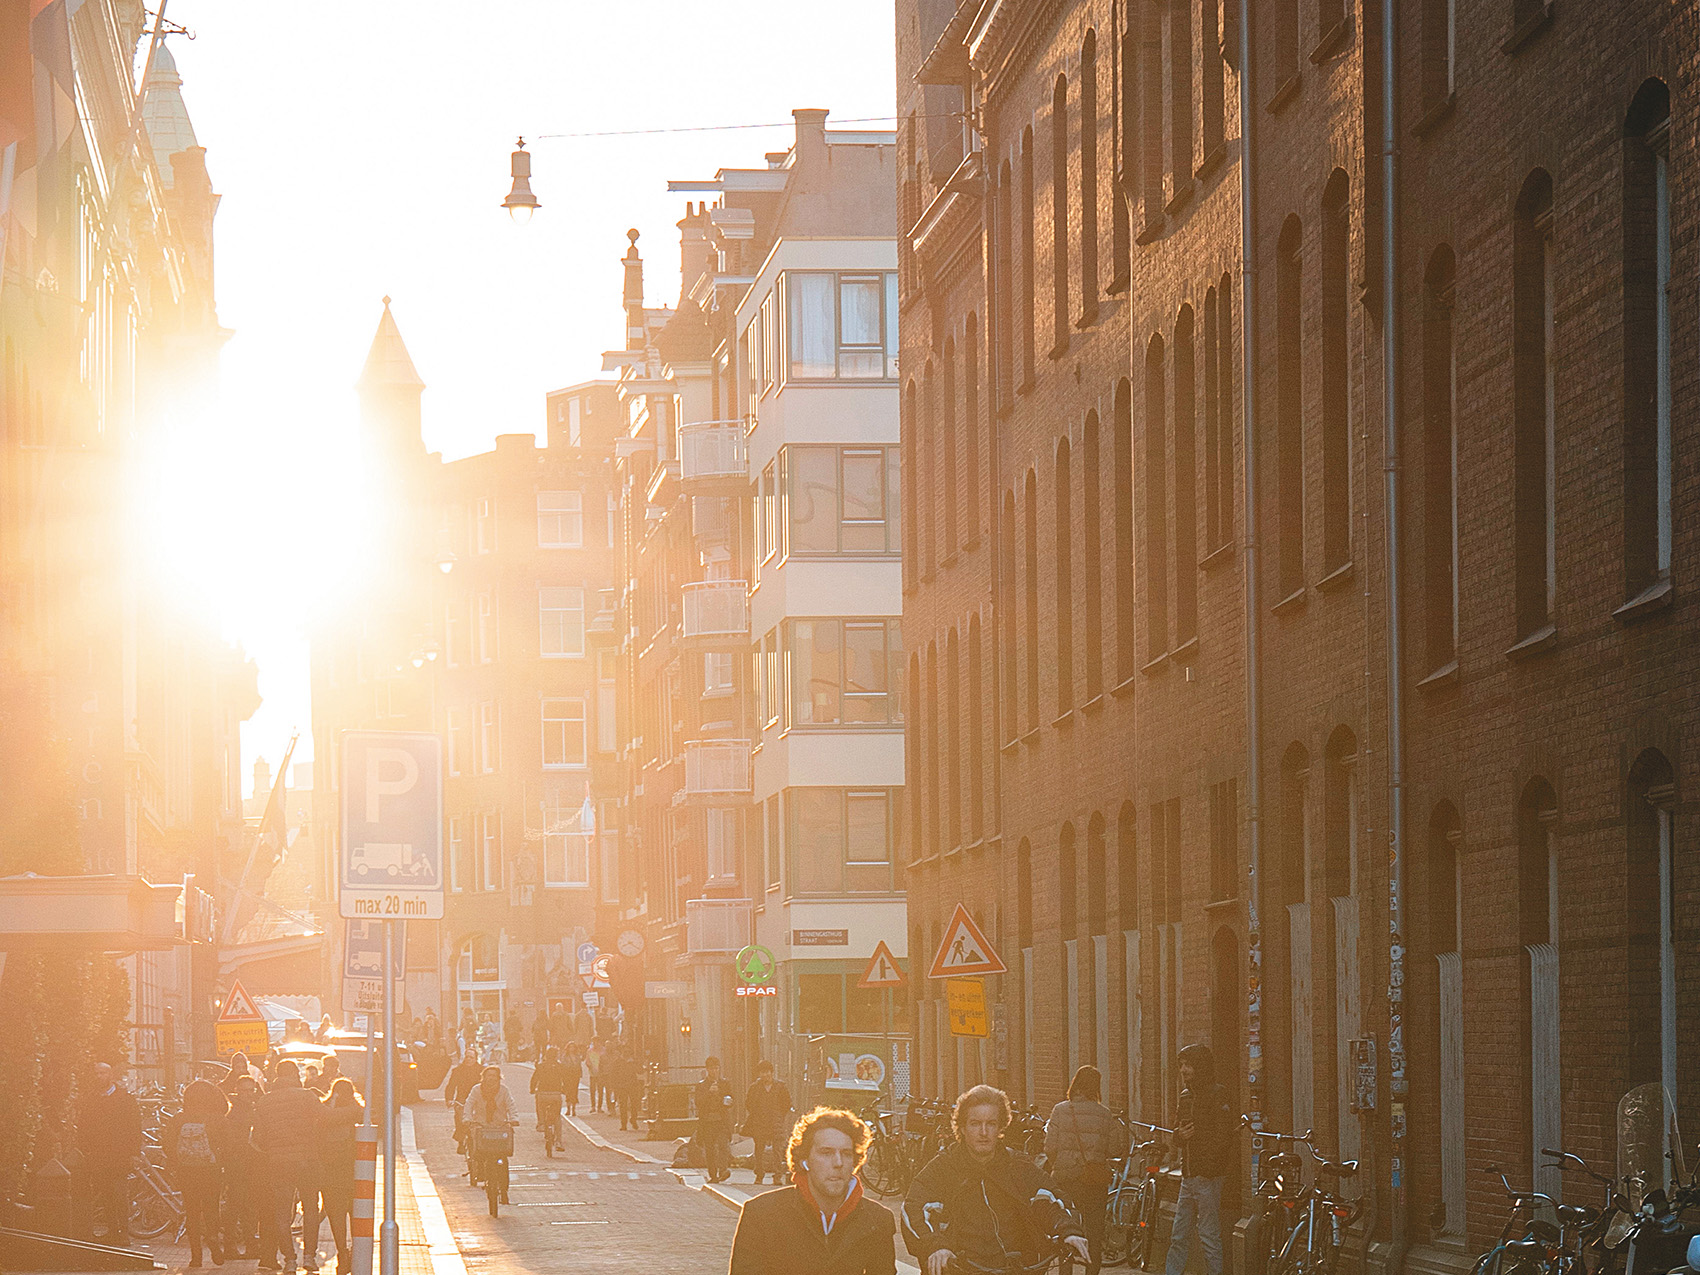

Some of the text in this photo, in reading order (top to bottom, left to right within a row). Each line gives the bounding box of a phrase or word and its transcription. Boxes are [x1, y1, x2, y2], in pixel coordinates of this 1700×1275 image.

[365, 748, 419, 823] P
[355, 895, 427, 915] max 20 min
[736, 987, 776, 996] SPAR
